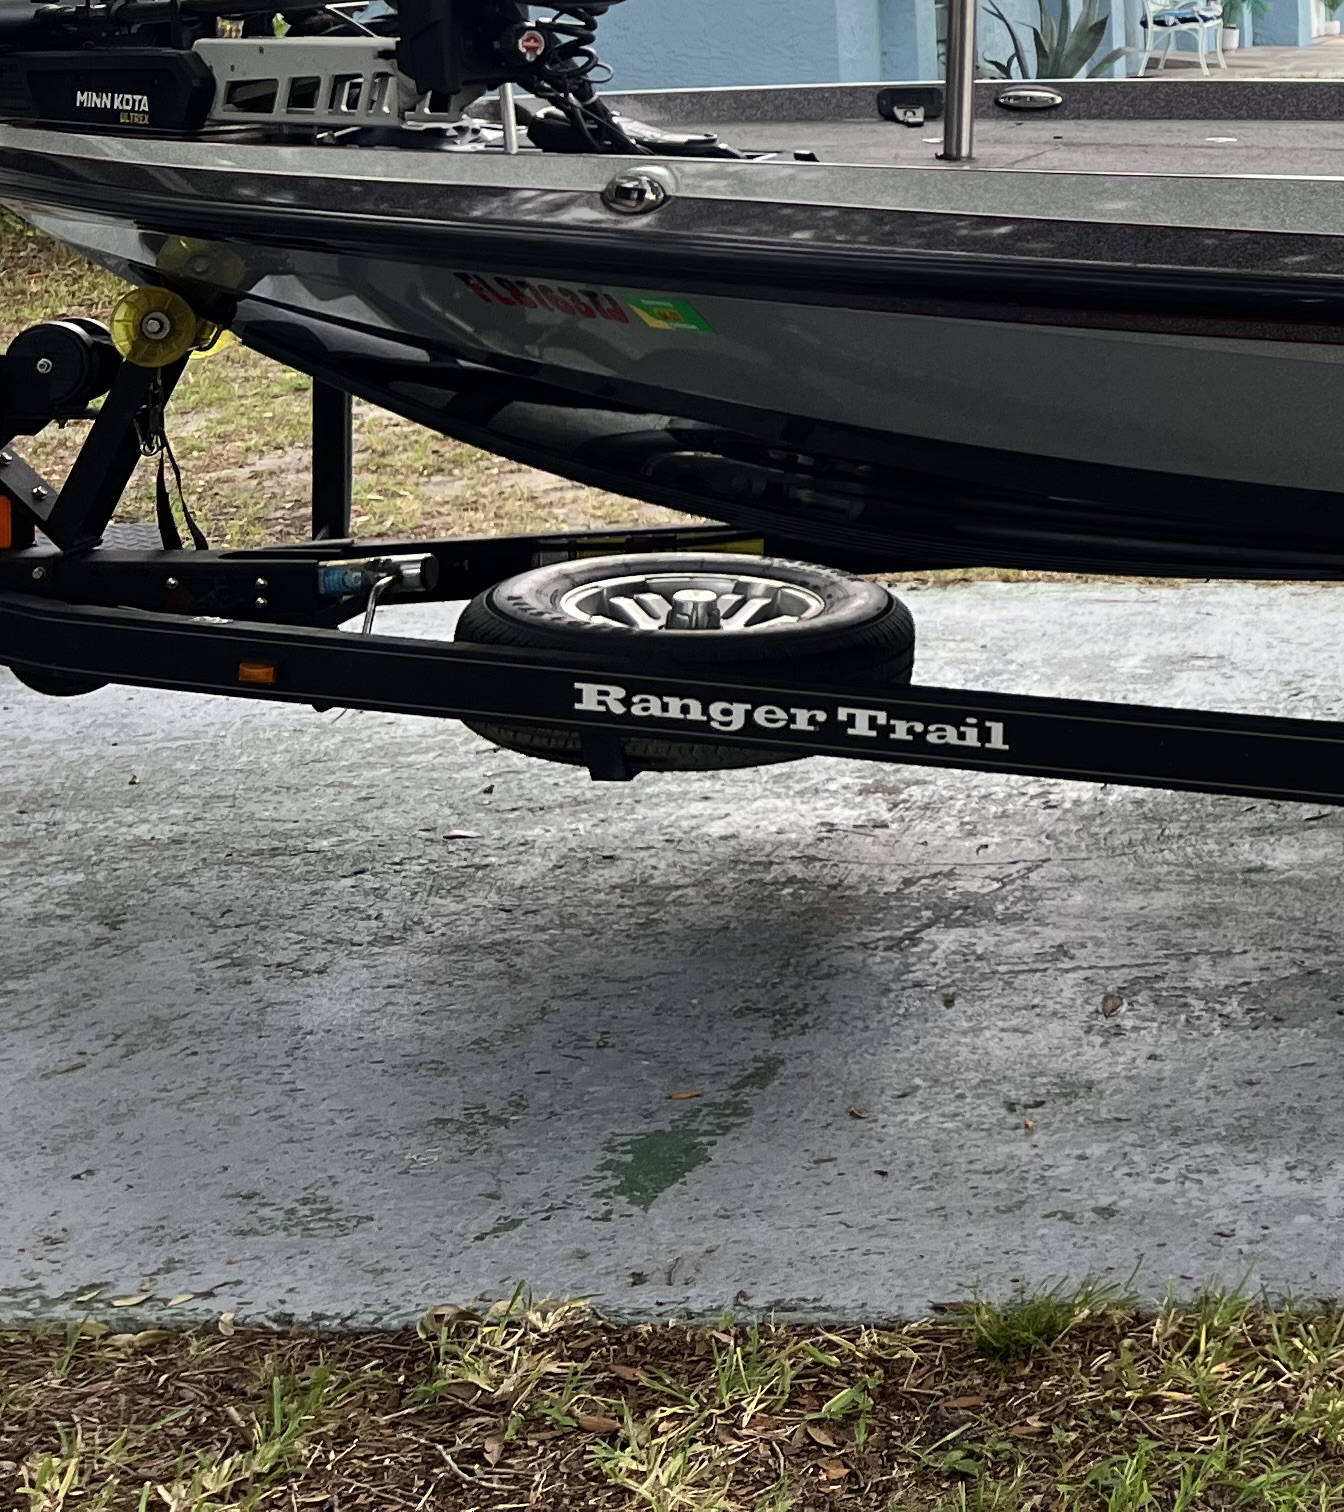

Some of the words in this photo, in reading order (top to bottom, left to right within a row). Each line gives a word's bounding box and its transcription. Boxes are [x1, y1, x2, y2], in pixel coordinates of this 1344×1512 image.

[75, 91, 112, 109] MINN
[113, 93, 149, 112] KOTA
[119, 112, 149, 125] ULTREX
[573, 681, 828, 732] Ranger
[837, 706, 1010, 751] Trail
